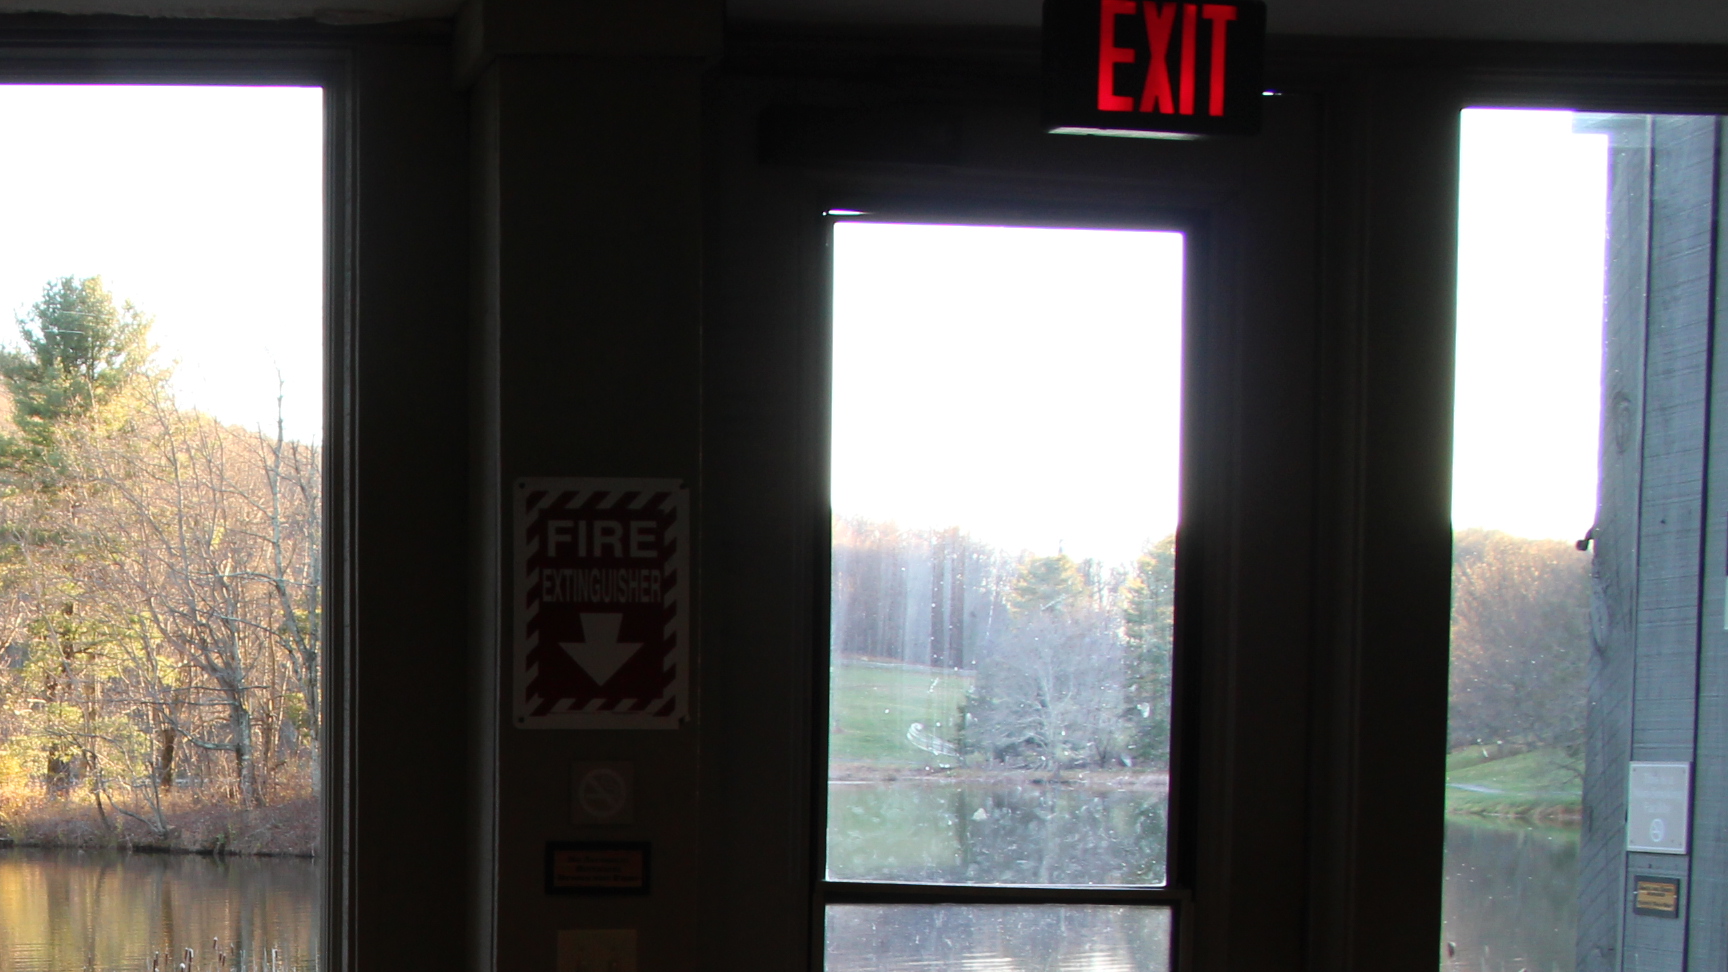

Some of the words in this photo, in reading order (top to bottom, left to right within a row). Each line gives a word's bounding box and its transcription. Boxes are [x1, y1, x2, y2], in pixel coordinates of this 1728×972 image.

[1097, 0, 1238, 117] EXIT
[547, 520, 659, 558] FIRE
[542, 568, 662, 603] EXTINGUISHER
